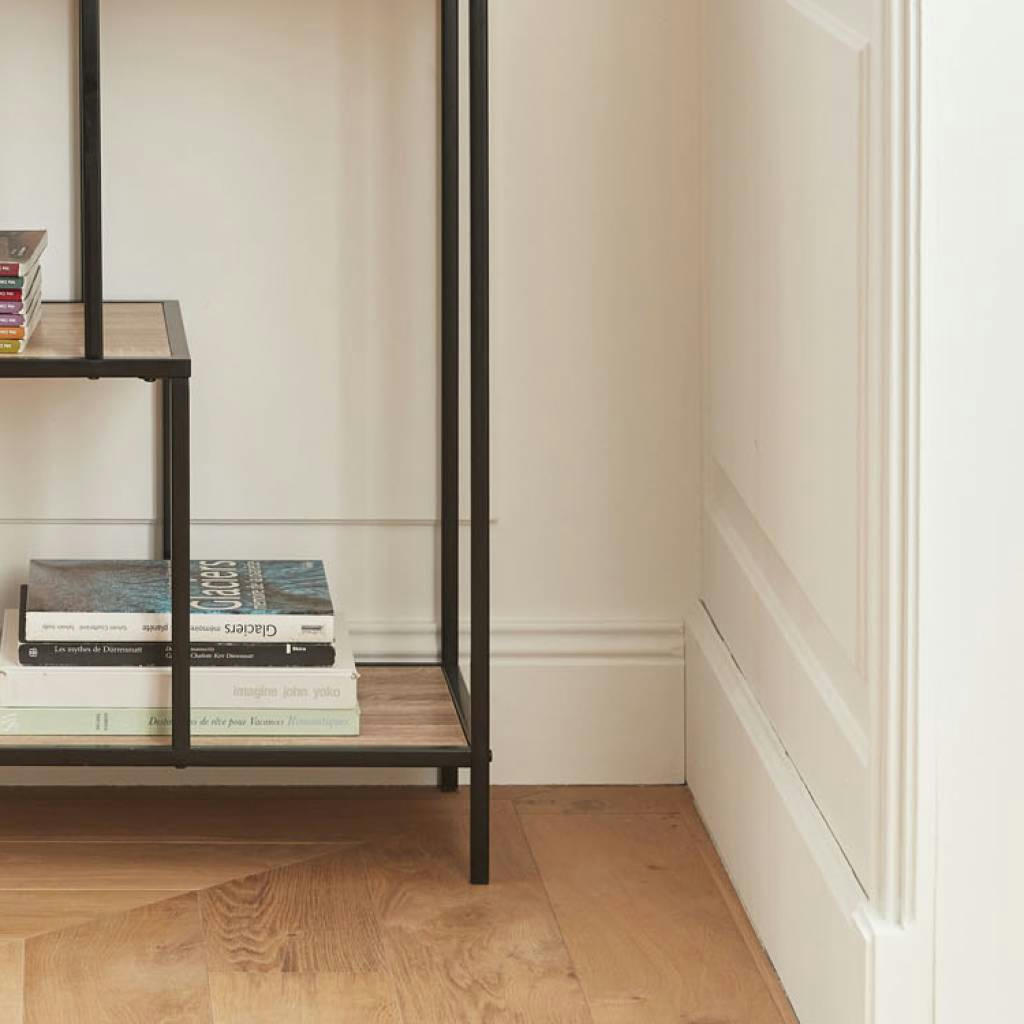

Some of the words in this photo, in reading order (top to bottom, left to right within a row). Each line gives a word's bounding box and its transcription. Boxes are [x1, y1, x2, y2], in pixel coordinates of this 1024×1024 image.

[190, 560, 243, 610] Glaciers
[224, 623, 277, 637] Glaciers
[54, 645, 66, 653] Les
[67, 645, 91, 654] mythes
[232, 685, 278, 699] imagine
[283, 685, 308, 699] john
[312, 685, 341, 699] yoko
[199, 716, 209, 726] de
[228, 718, 247, 728] pour
[250, 716, 284, 726] Vacances
